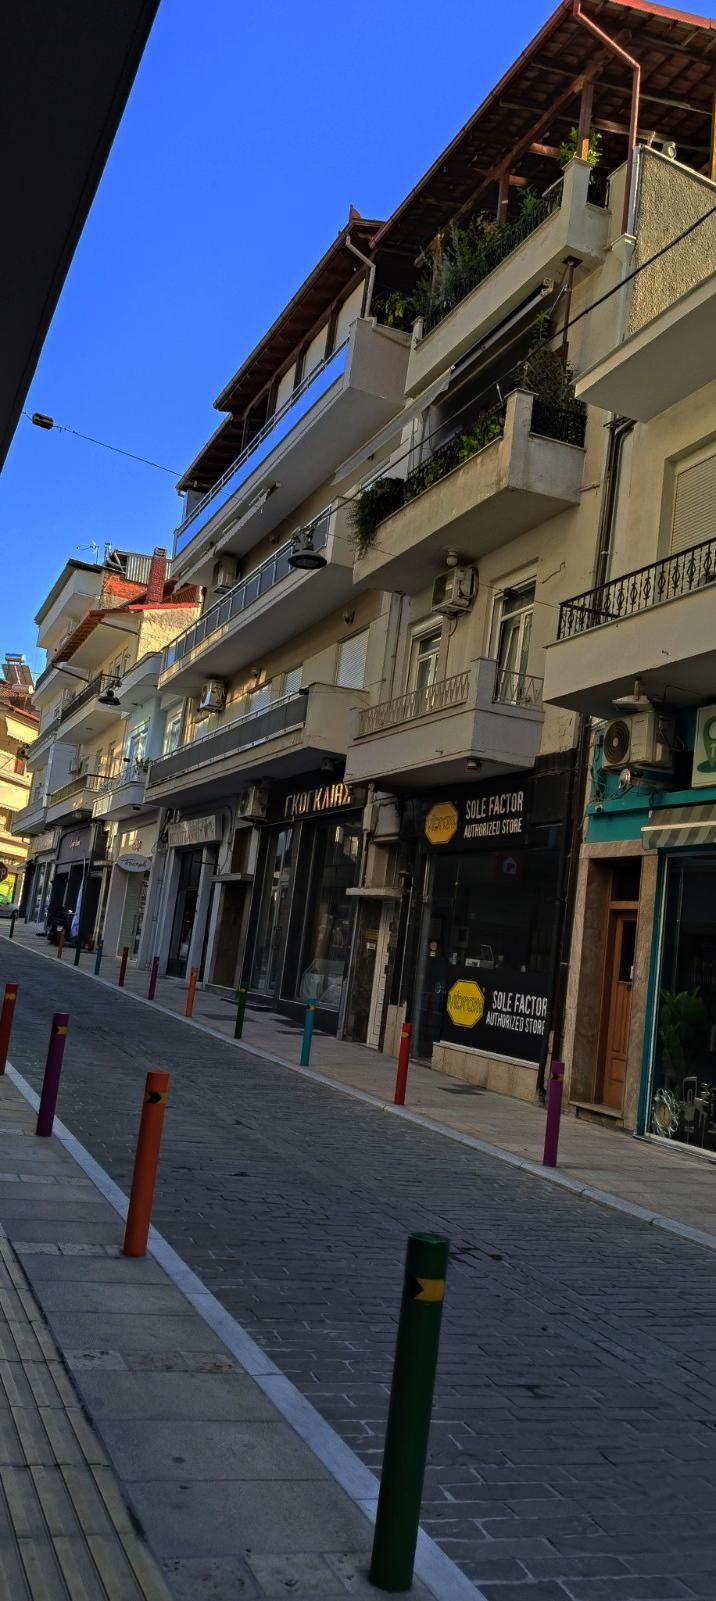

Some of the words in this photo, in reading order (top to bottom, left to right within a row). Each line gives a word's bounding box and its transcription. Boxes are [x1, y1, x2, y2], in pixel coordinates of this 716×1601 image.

[284, 782, 352, 817] ΓΚΟΓΚΛΙΑΣ
[465, 797, 487, 820] SOLE
[488, 791, 524, 816] FACTOR
[463, 820, 501, 839] AUTHORIZED
[501, 817, 523, 834] STORE
[492, 990, 513, 1012] SOLE
[514, 993, 548, 1018] FACTOR
[485, 1010, 524, 1032] AUTHORIZED
[524, 1017, 546, 1036] STORE
